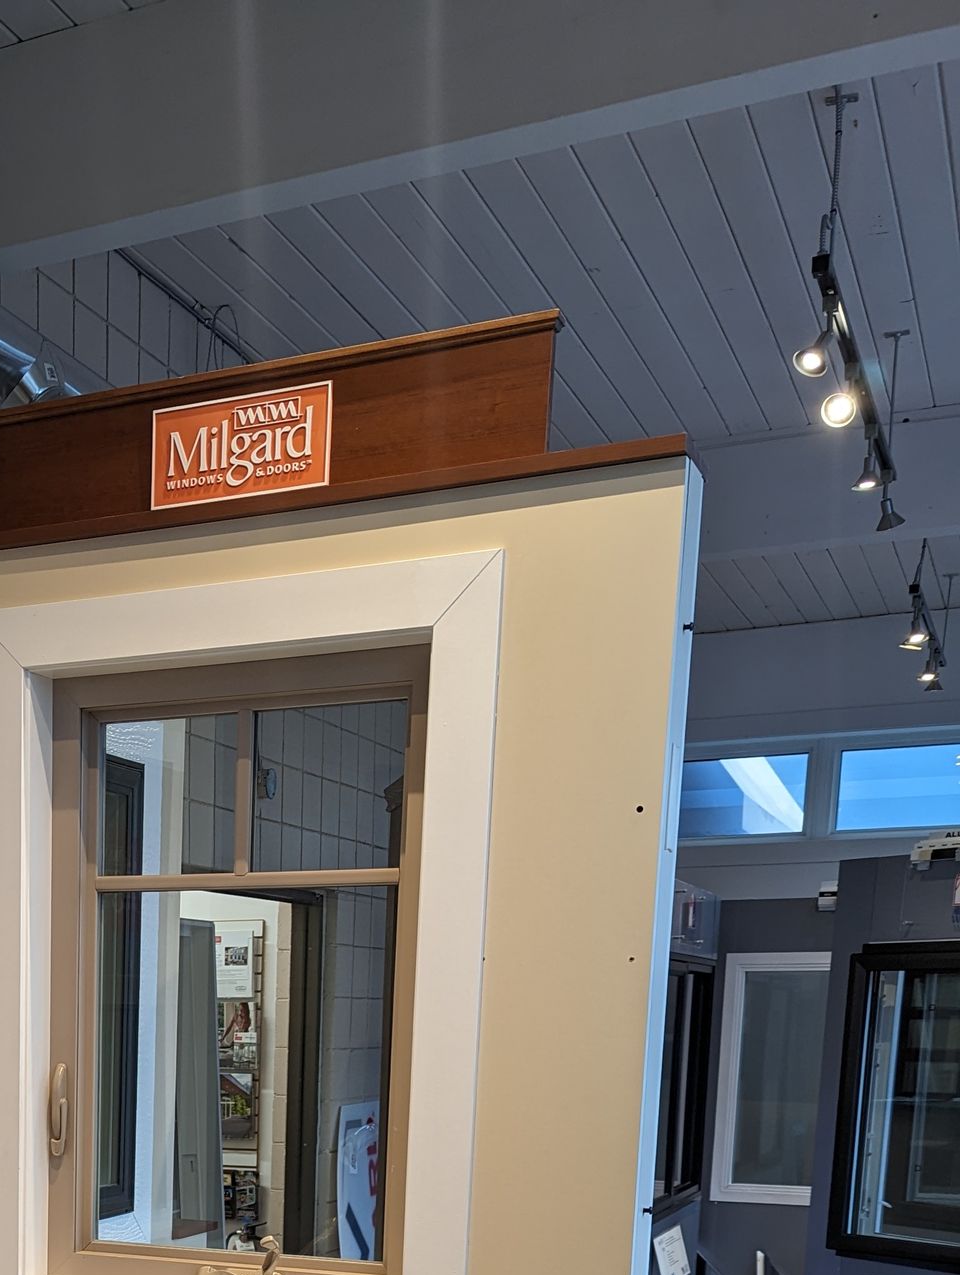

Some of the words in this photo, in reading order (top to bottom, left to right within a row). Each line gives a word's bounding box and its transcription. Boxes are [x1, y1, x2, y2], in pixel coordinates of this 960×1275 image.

[167, 405, 314, 487] Milgard
[166, 474, 223, 490] WINDOWS
[255, 466, 266, 477] &
